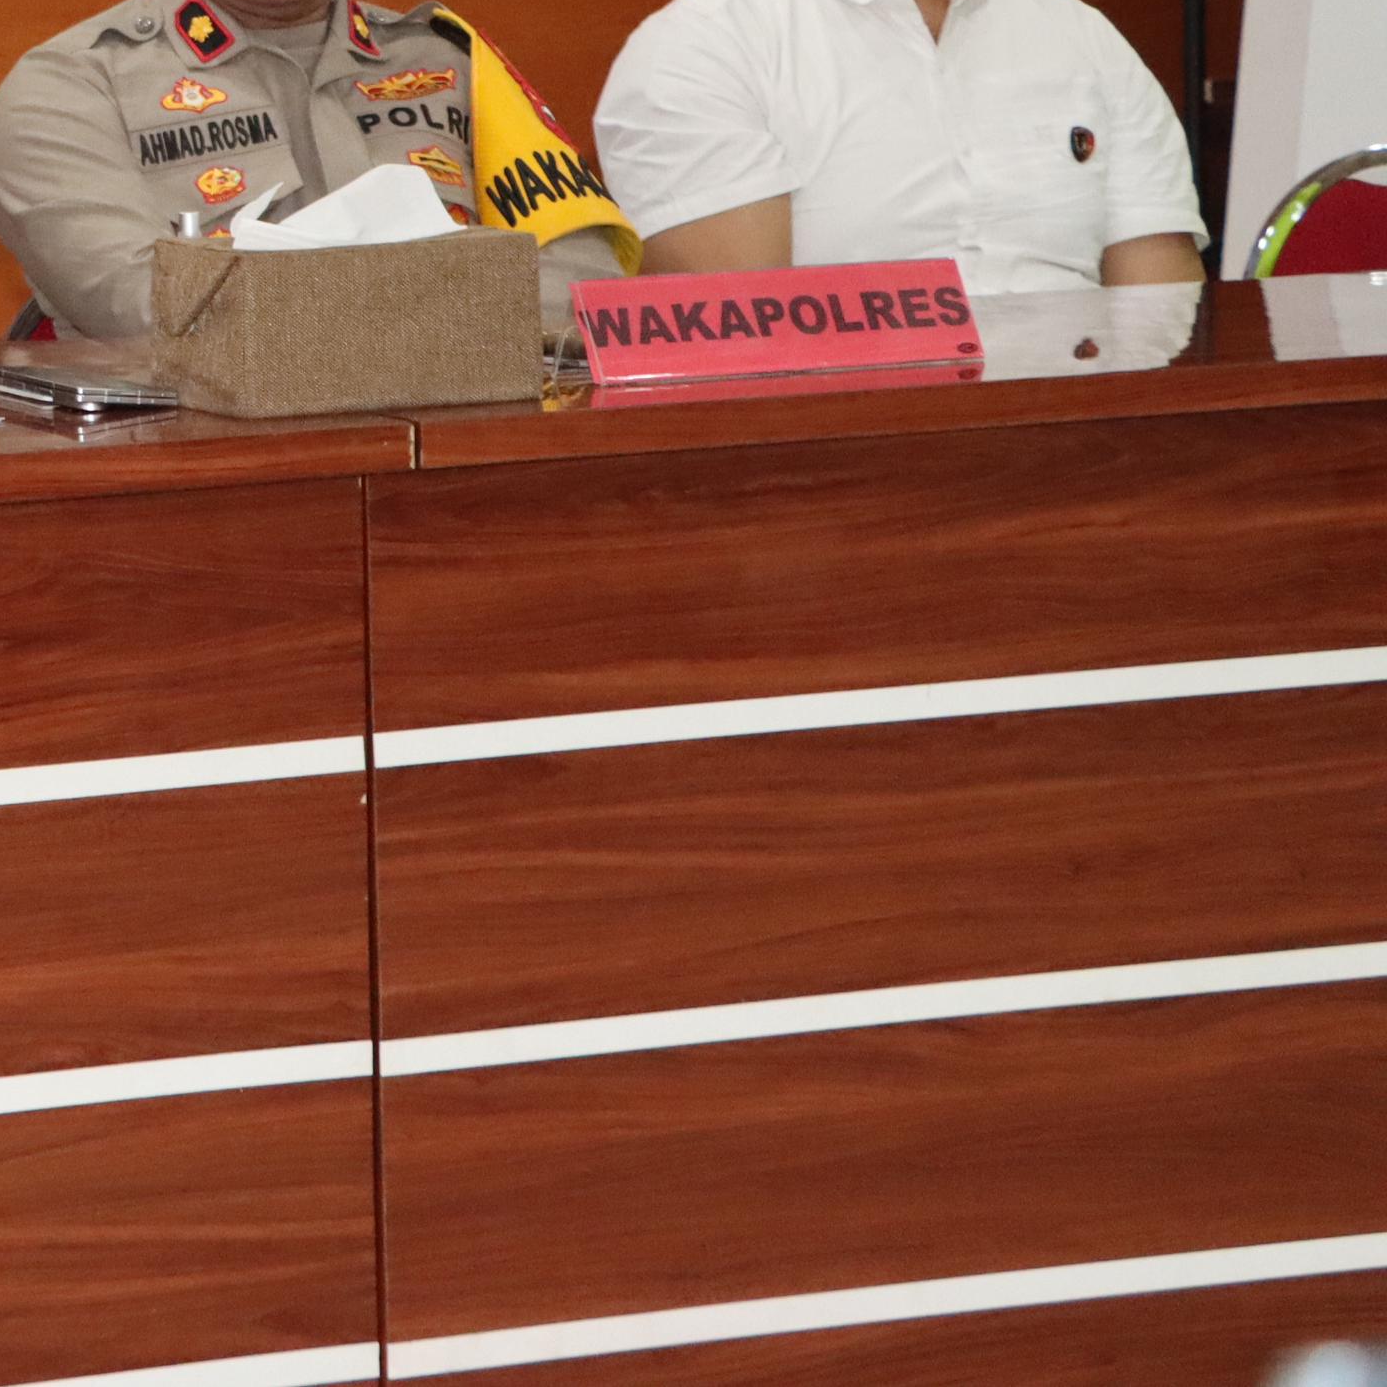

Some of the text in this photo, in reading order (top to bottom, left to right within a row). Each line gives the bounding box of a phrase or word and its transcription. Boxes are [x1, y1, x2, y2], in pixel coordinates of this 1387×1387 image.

[140, 112, 278, 166] AHMAD.ROSMA
[357, 104, 470, 145] POLRI
[485, 150, 619, 228] WAKA
[579, 286, 972, 349] WAKAPOLRES
